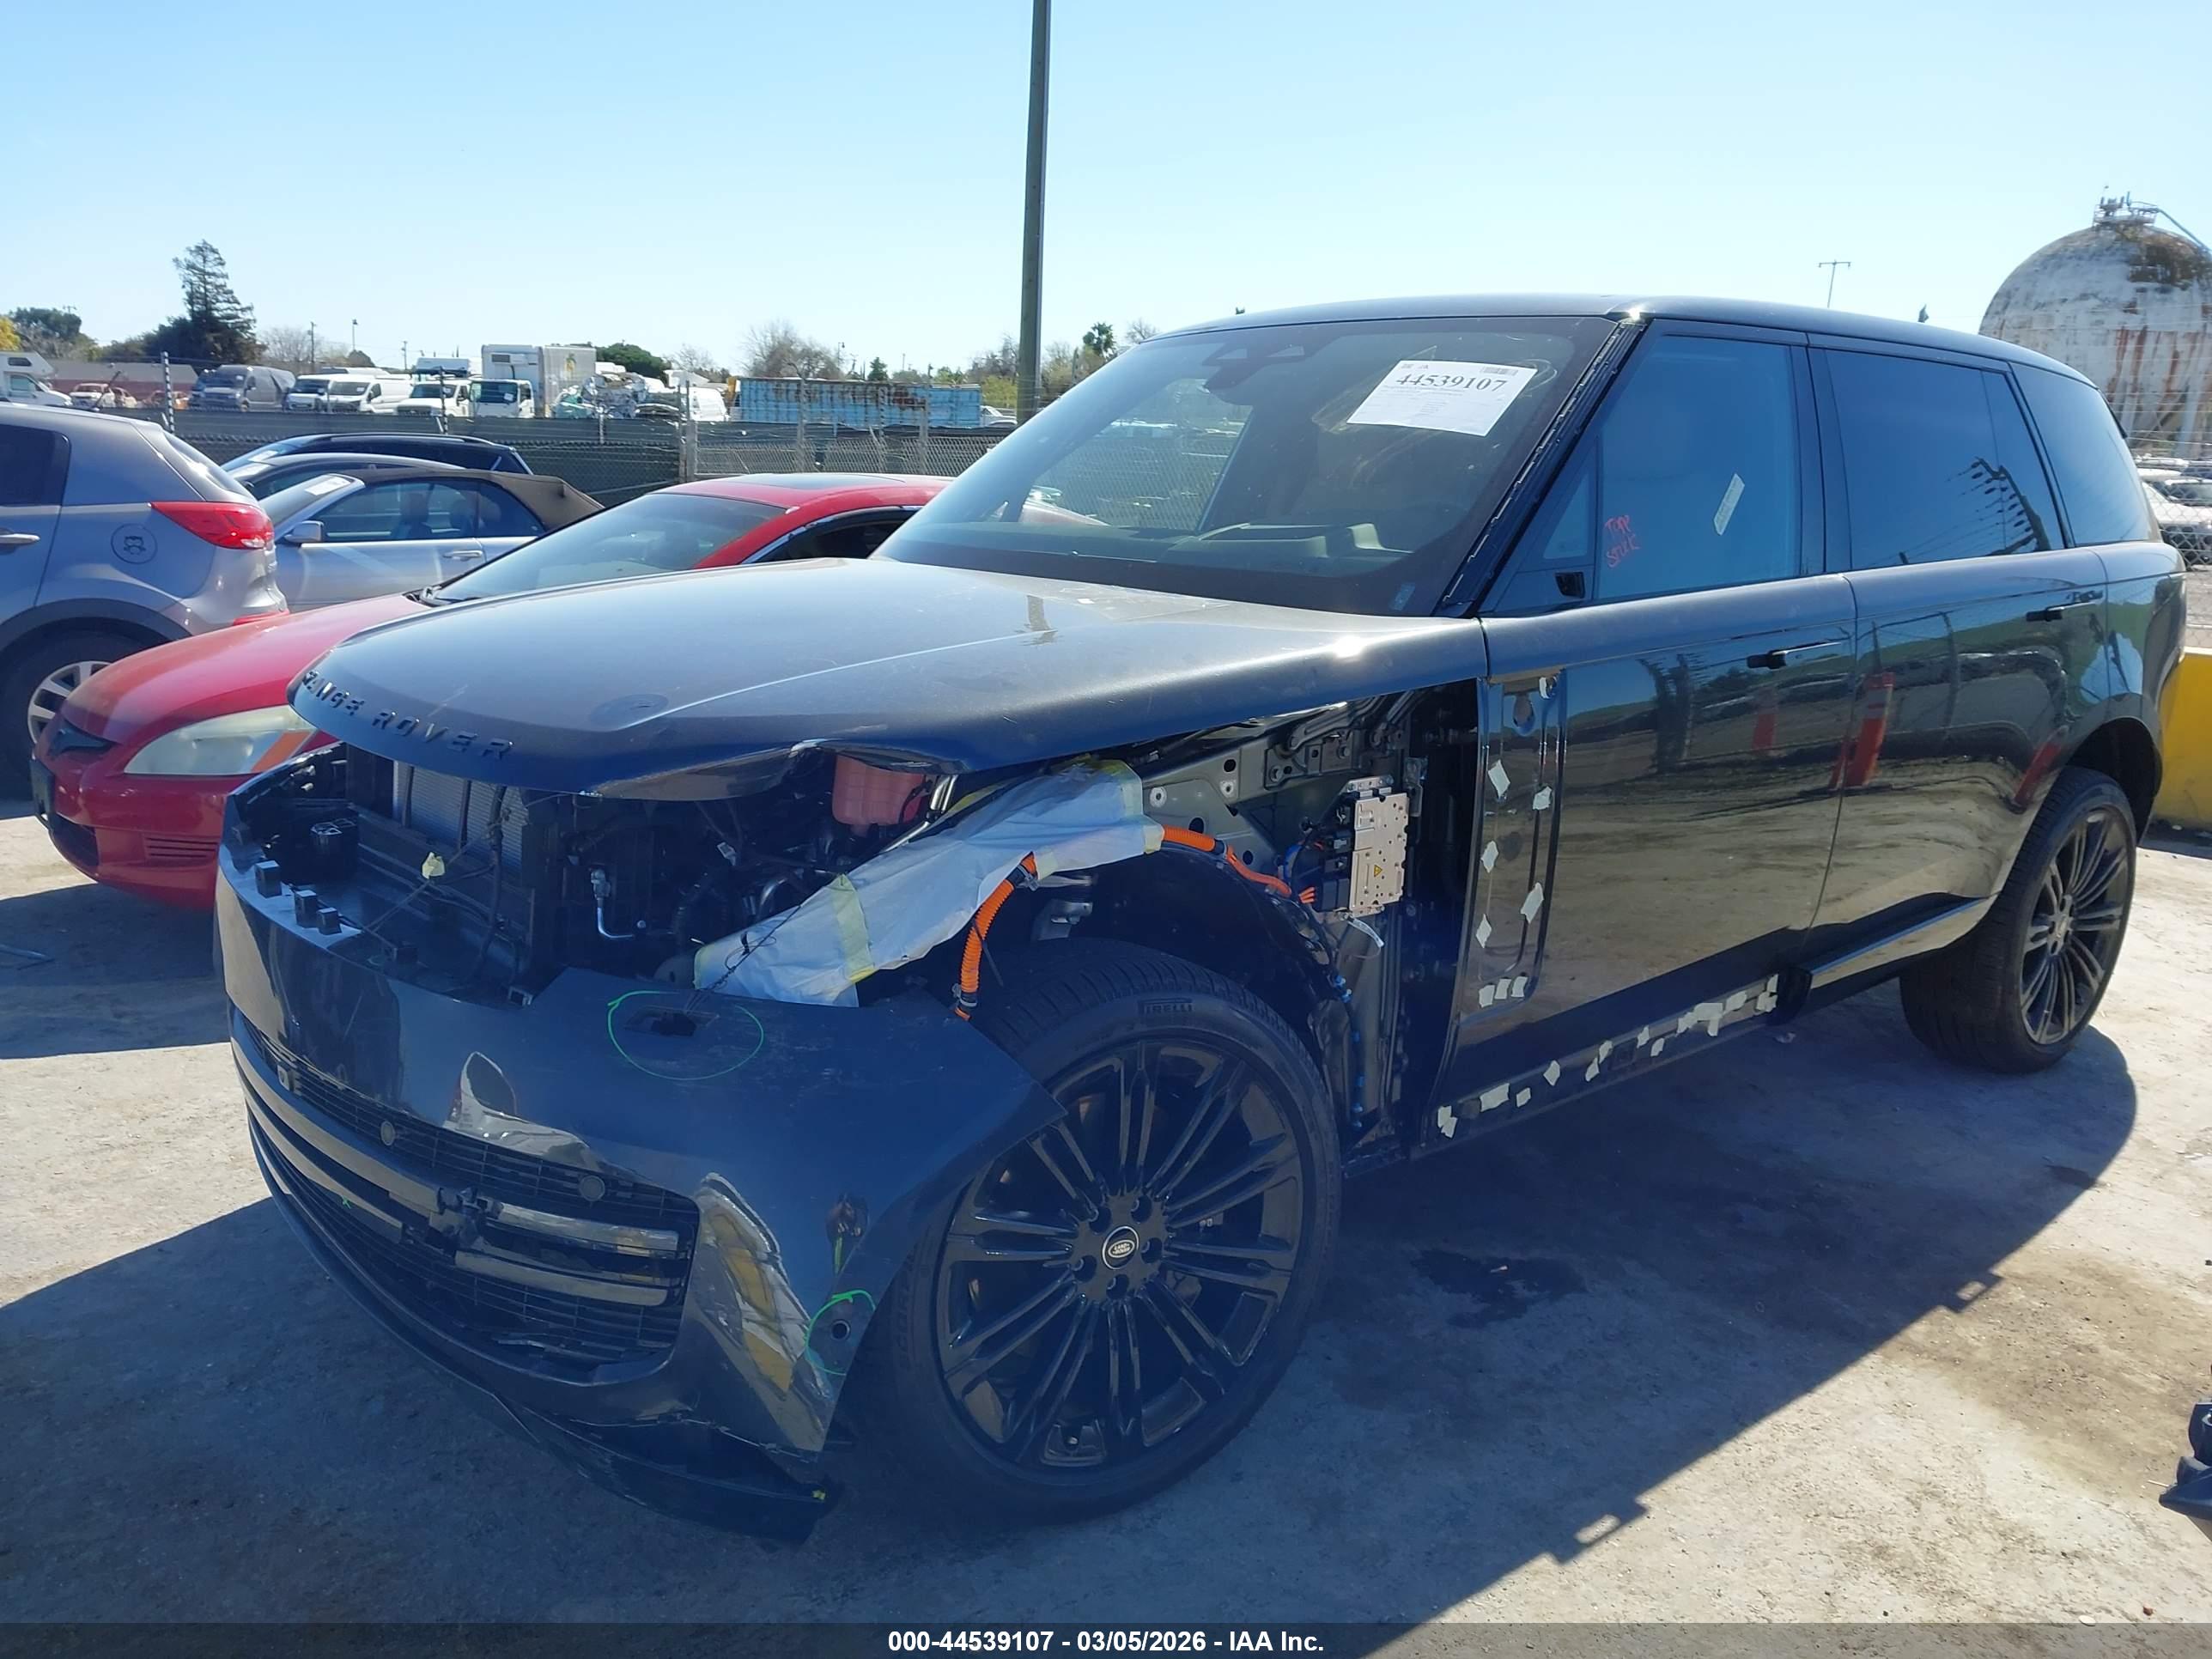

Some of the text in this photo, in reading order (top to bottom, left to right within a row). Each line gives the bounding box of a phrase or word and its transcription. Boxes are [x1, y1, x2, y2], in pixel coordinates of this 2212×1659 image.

[1396, 374, 1508, 392] 44539107
[301, 670, 514, 760] RANGE ROVER
